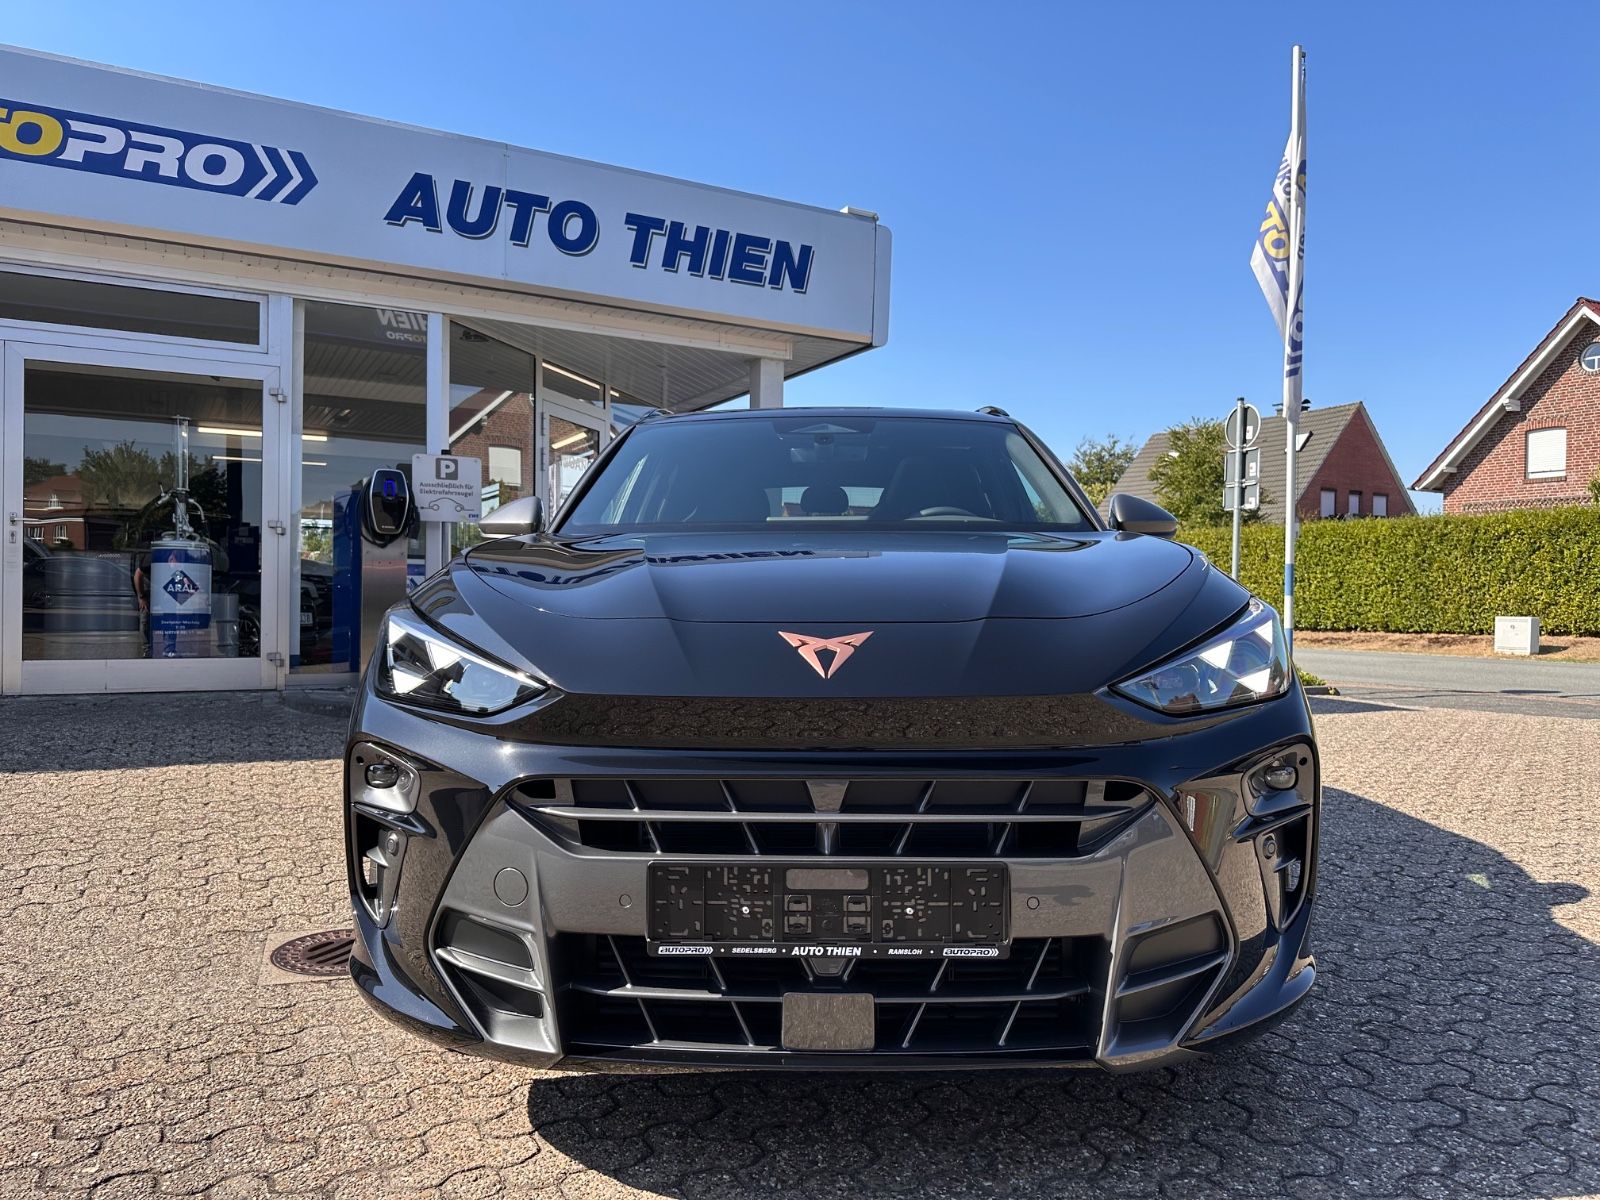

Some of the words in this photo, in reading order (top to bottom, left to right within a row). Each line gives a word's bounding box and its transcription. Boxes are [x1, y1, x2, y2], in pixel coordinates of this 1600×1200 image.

[0, 107, 245, 186] OPRO
[384, 172, 599, 257] AUTO
[625, 212, 814, 293] THIEN
[440, 460, 456, 479] P
[167, 584, 195, 592] ARAL
[791, 946, 824, 956] AUTO
[826, 946, 862, 956] THIEN
